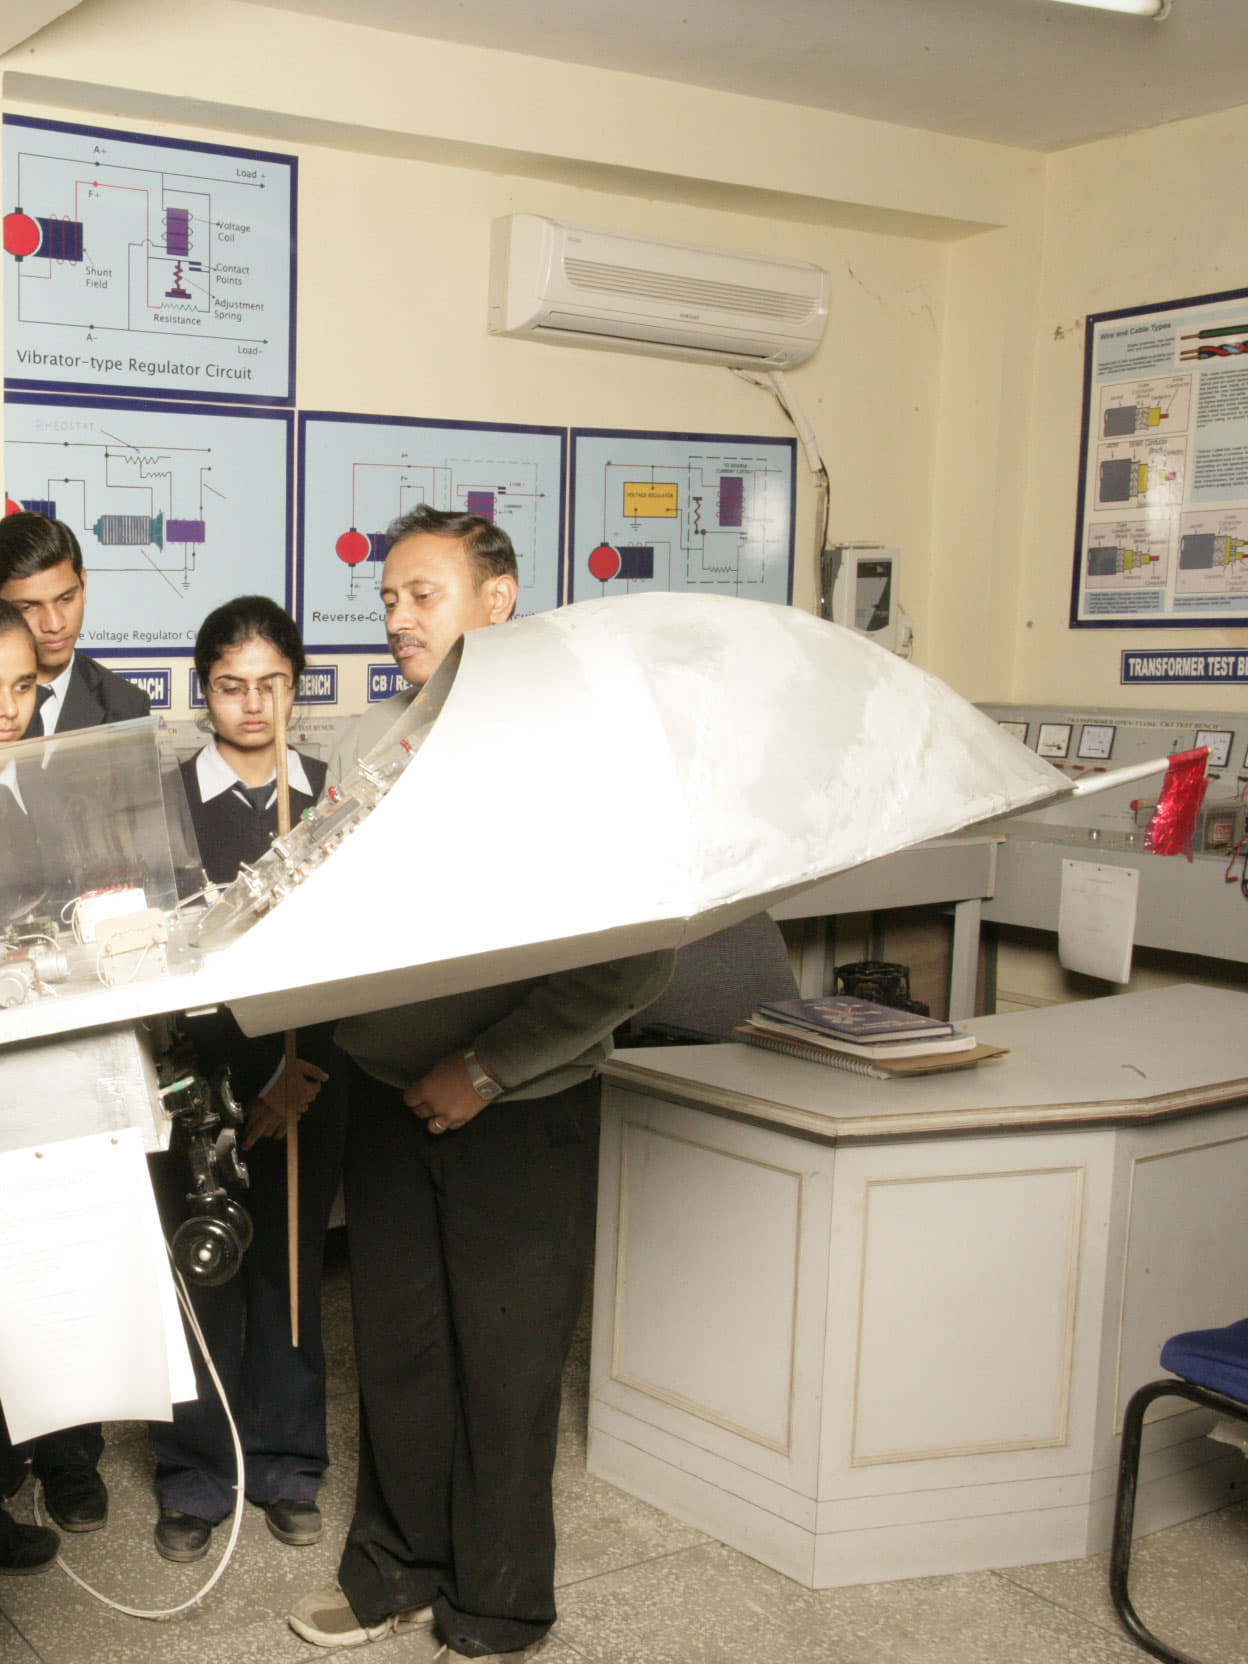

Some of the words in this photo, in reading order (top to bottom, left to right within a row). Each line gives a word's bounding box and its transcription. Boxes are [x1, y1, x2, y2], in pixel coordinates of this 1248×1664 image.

[236, 168, 257, 179] Load
[218, 222, 251, 233] Voltage
[217, 232, 235, 242] Coil
[85, 266, 113, 278] Shunt
[216, 263, 249, 274] Contact
[86, 278, 108, 289] Field
[216, 275, 242, 286] Points
[214, 298, 264, 312] Adjustment
[153, 313, 201, 326] Resistance
[214, 310, 242, 322] Spring
[16, 349, 123, 373] Vibrator-type
[128, 358, 200, 377] Regulator
[205, 363, 253, 380] Circuit
[312, 611, 386, 623] Reverse-Cu
[89, 631, 129, 643] Voltage
[132, 630, 183, 643] Regulator
[1128, 657, 1205, 677] TRANSFORMER
[1207, 657, 1236, 676] TEST
[372, 675, 388, 692] CB
[395, 675, 414, 691] RE
